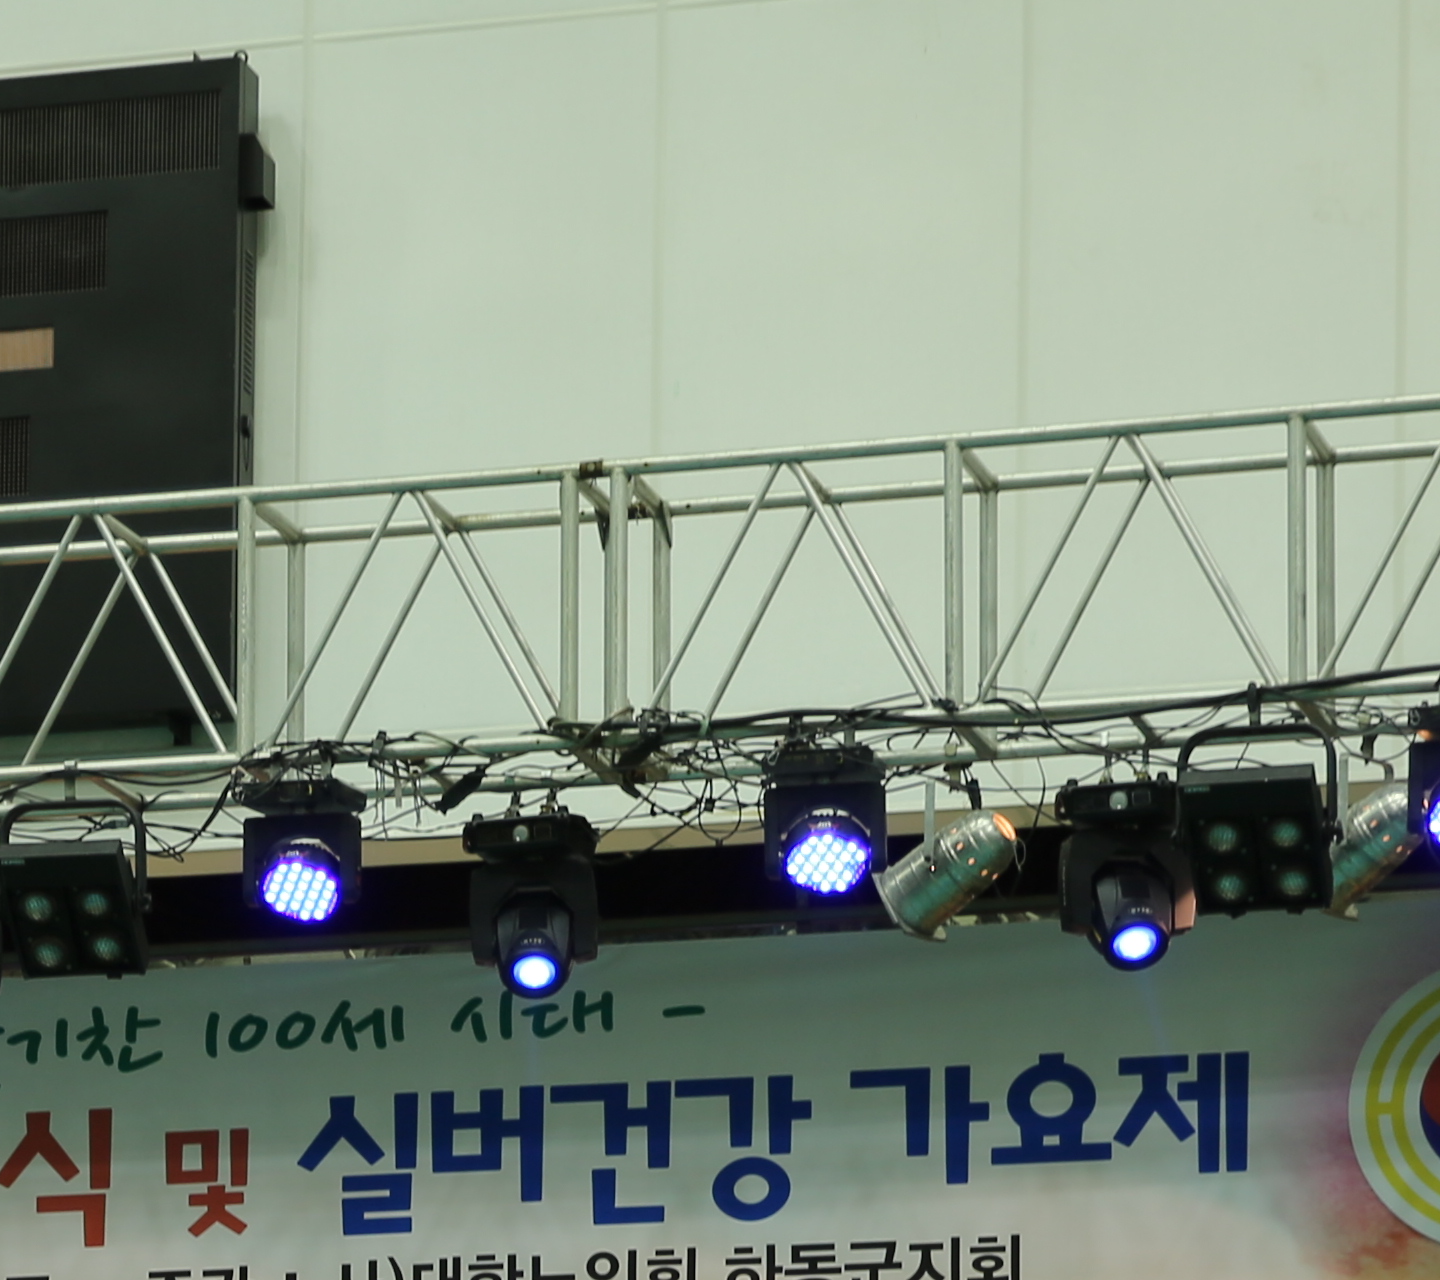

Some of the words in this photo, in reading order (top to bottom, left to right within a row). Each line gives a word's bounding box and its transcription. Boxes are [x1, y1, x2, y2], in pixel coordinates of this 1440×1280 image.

[205, 1000, 405, 1058] 100세
[450, 990, 614, 1044] 시대
[164, 1127, 250, 1239] 및
[297, 1074, 812, 1236] 실버건강
[850, 1050, 1250, 1185] 가요제
